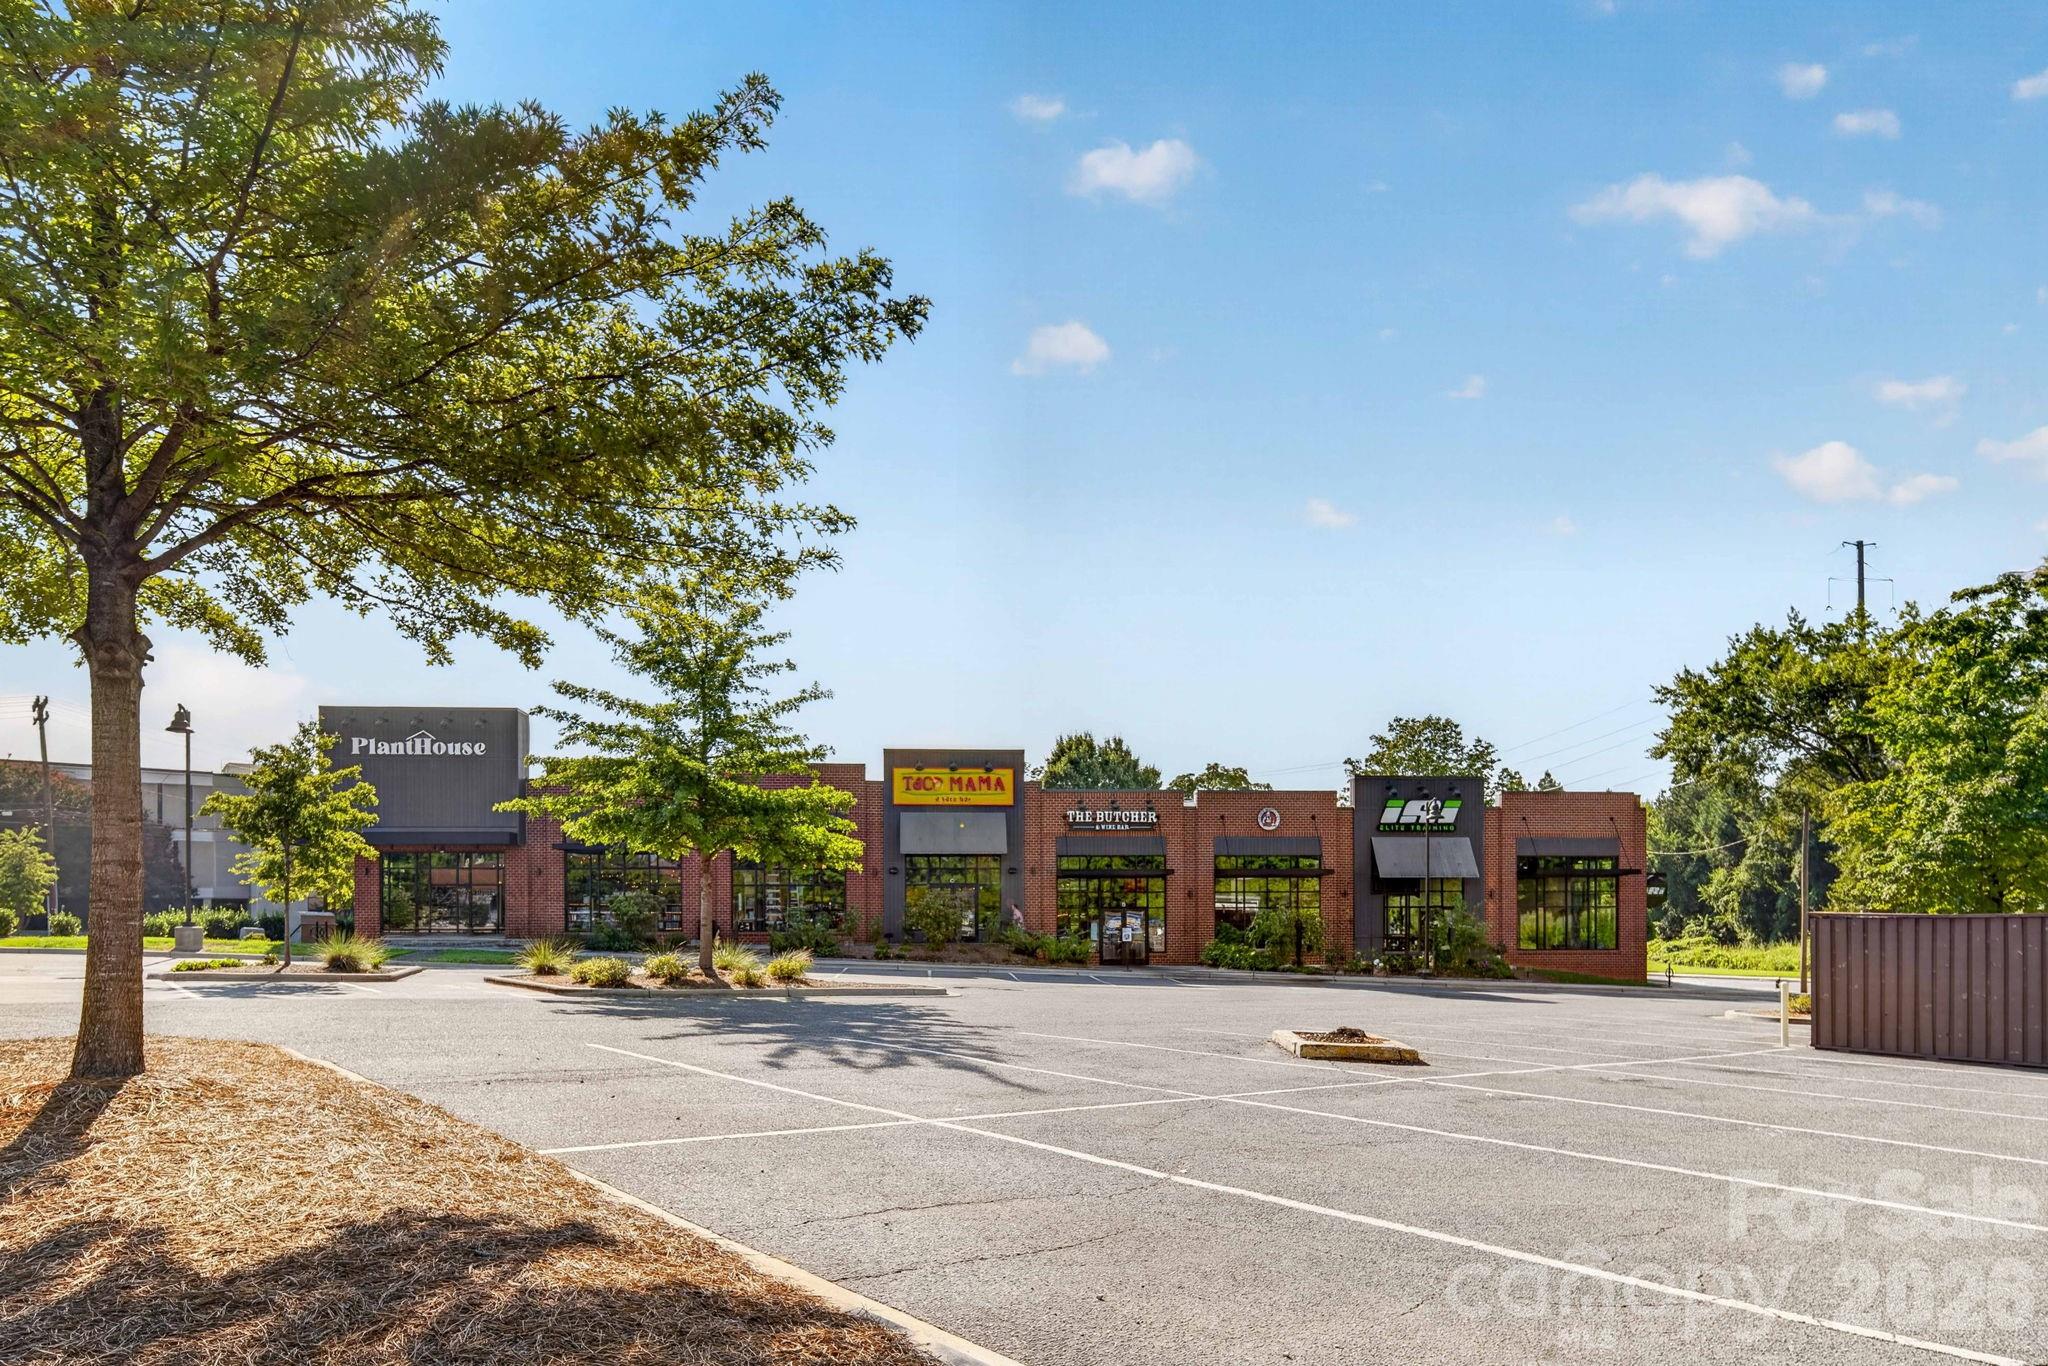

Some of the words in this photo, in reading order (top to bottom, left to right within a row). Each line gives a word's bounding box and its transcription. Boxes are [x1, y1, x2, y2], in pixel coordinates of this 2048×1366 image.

[351, 736, 487, 756] PlantHouse
[949, 775, 1006, 792] MAMA
[1066, 810, 1093, 822] THE
[1096, 810, 1158, 823] BUTCHER
[1410, 824, 1455, 832] TRAINING
